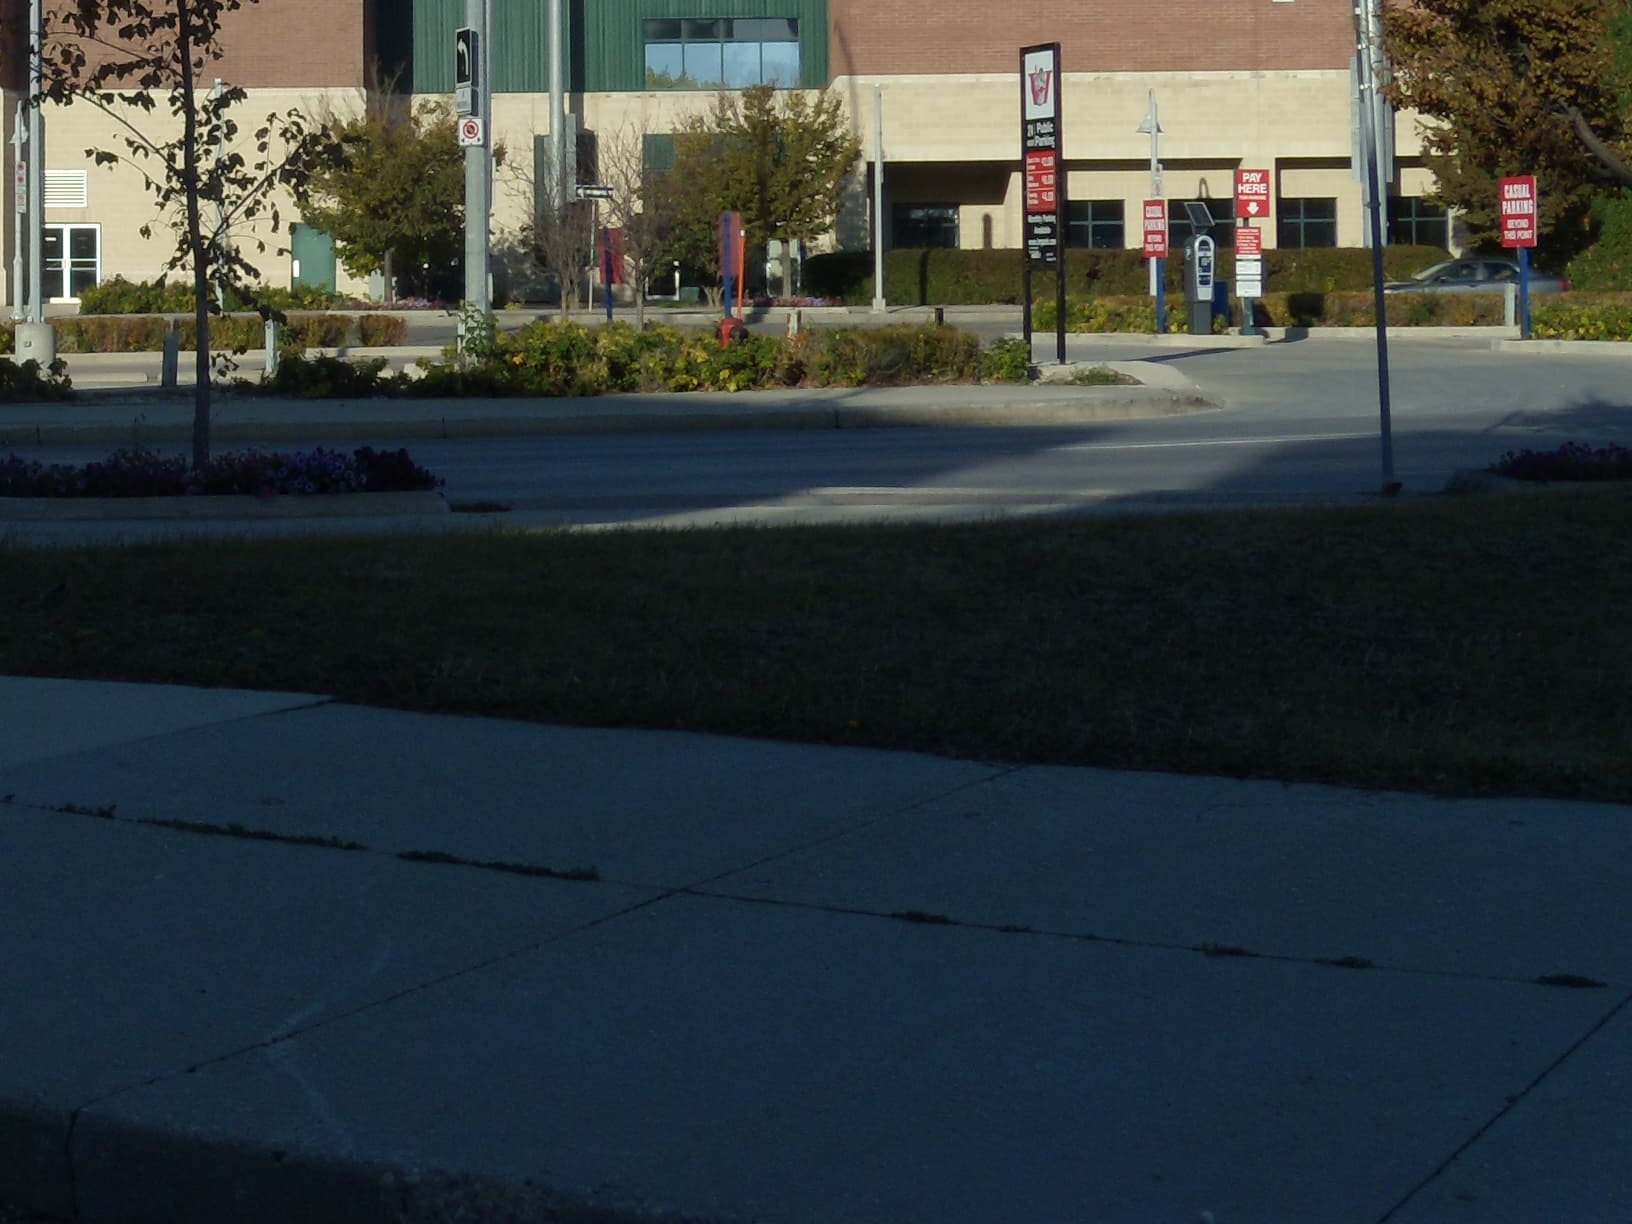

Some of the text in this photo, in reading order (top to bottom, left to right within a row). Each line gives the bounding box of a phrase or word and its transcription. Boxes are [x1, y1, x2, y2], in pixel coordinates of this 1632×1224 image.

[1036, 121, 1054, 133] Public
[1035, 135, 1055, 148] Parking
[1242, 172, 1263, 183] PAY
[1237, 183, 1268, 194] HERE
[1504, 184, 1530, 199] CASUAL
[1502, 199, 1533, 215] PARKING
